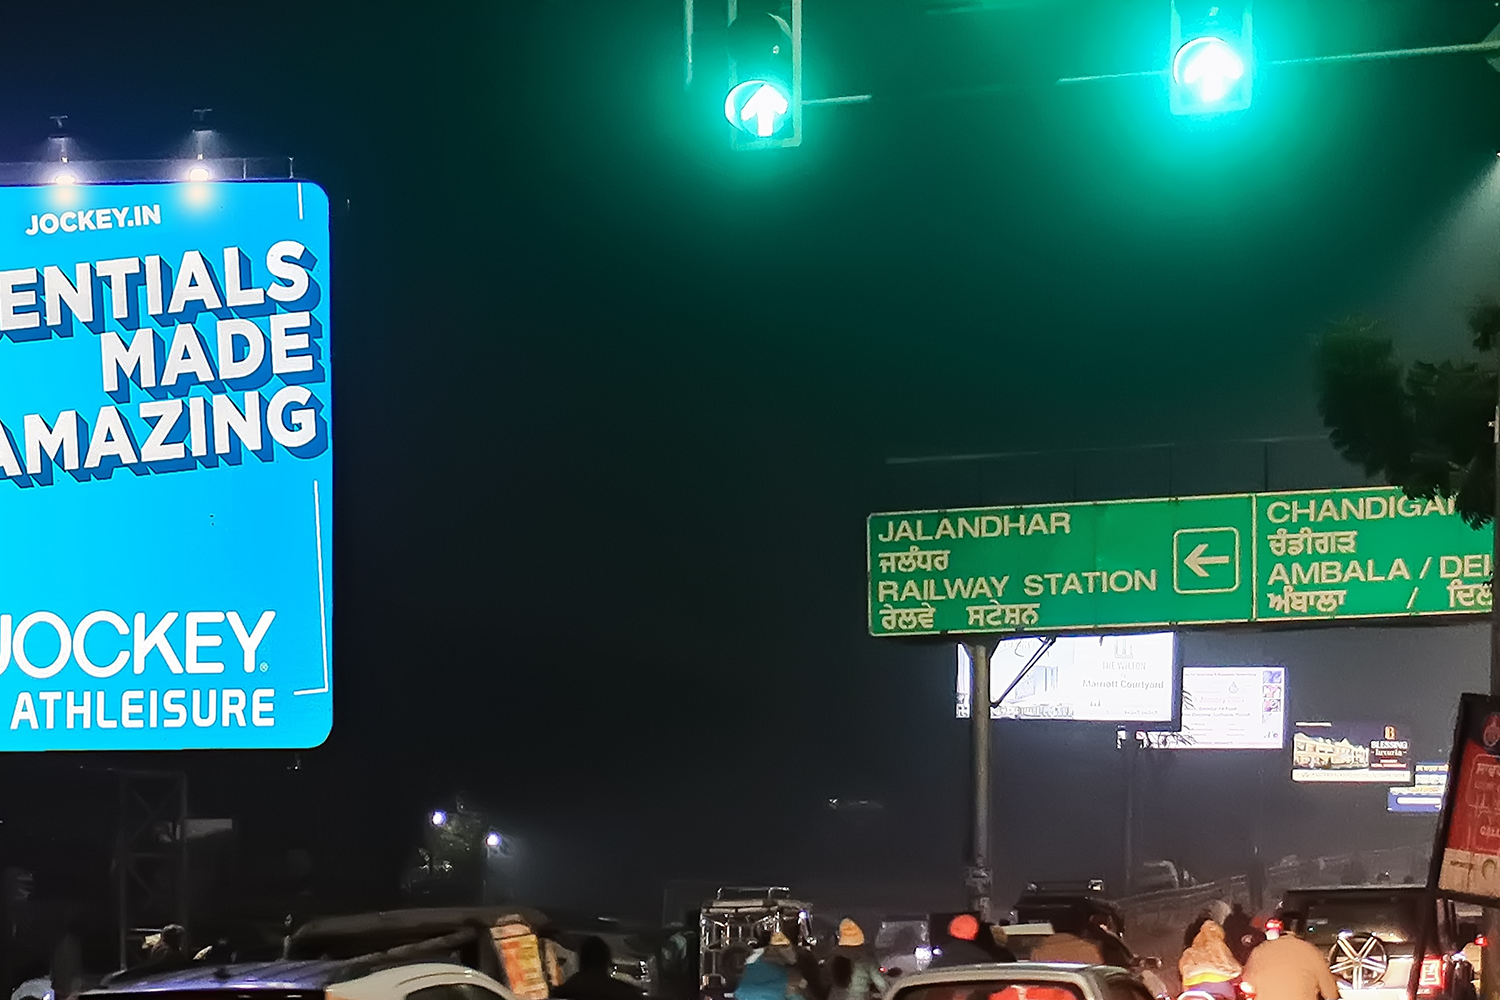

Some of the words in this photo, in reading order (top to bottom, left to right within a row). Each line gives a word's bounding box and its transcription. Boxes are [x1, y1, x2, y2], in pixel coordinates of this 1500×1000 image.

[25, 204, 161, 236] JOCKEY.IN
[100, 311, 314, 393] MADE
[1267, 495, 1456, 524] CHANDIGA
[878, 512, 1071, 543] JALANDHAR
[878, 574, 1010, 603] RAILWAY
[1024, 569, 1158, 597] STATION
[1267, 558, 1411, 586] AMBALA
[879, 602, 936, 630] ਰੇਲਵੇ
[1082, 679, 1118, 688] Marriott
[1120, 680, 1164, 690] Courtyard
[10, 688, 275, 730] ATHLEISURE
[1370, 740, 1408, 749] BLESSING
